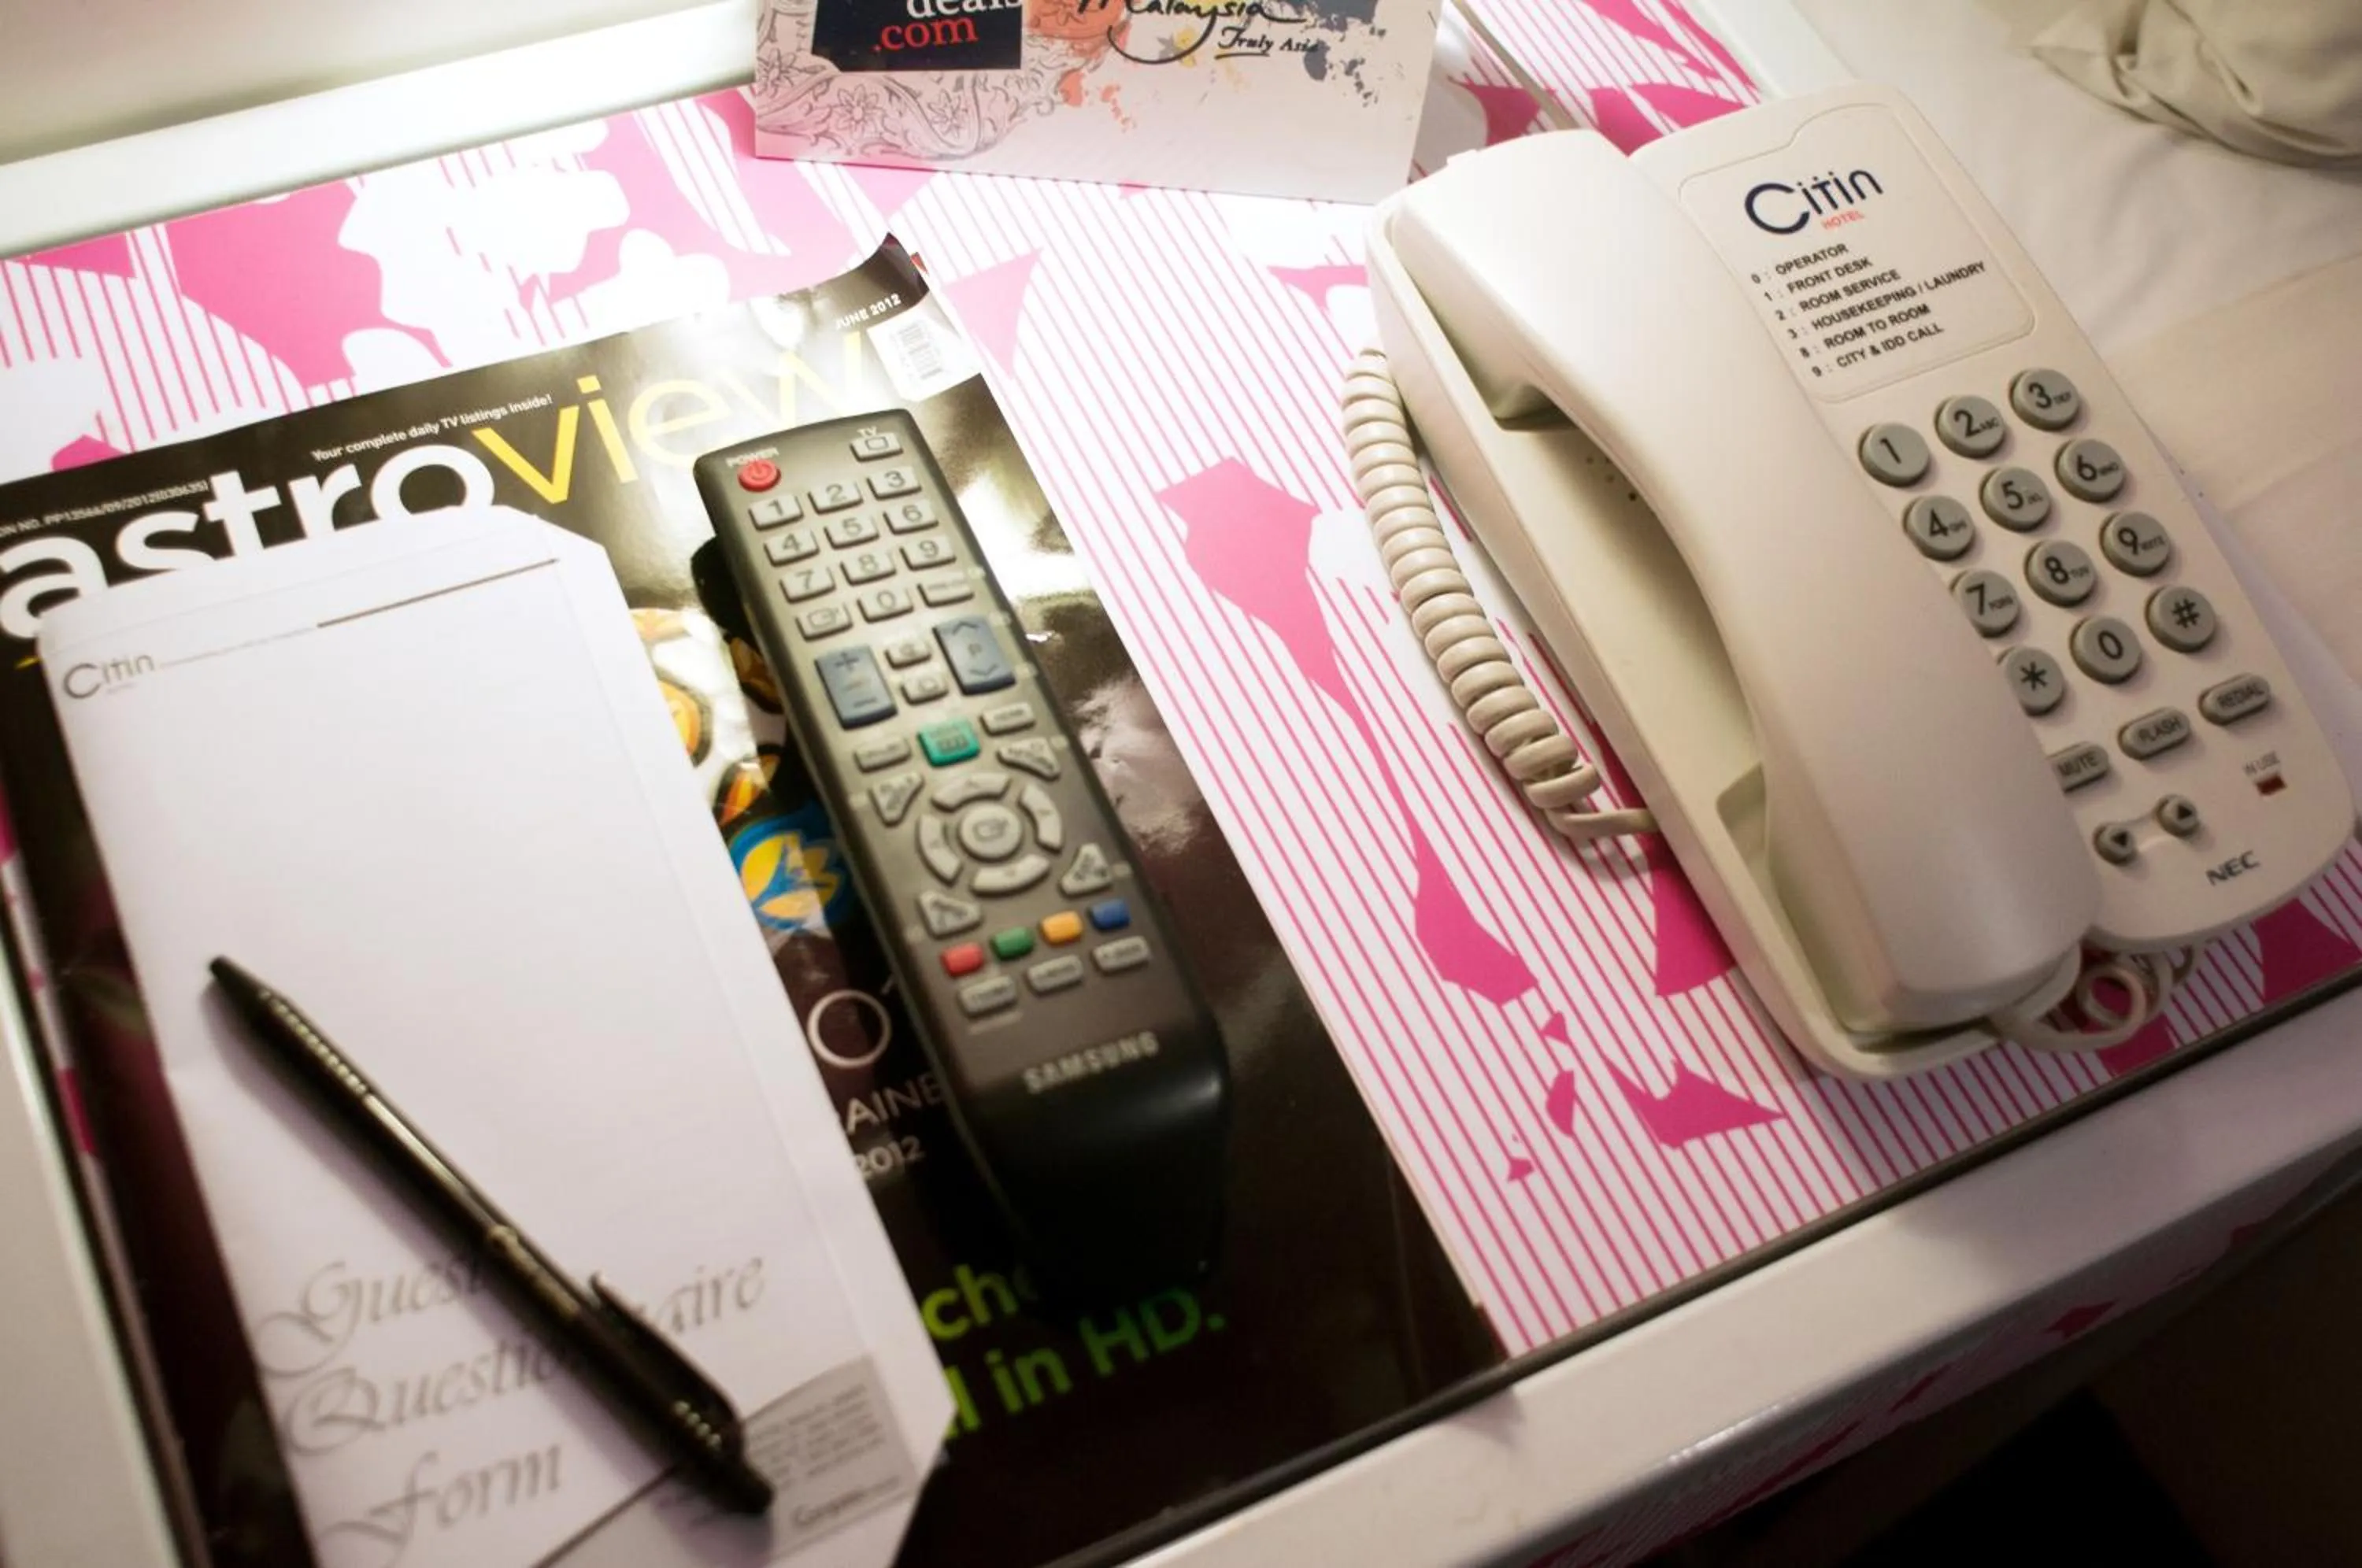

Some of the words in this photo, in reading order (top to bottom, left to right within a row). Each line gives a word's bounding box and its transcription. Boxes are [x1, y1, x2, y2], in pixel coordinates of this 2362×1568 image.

[906, 0, 1021, 19] dea
[872, 17, 979, 52] .com
[1218, 26, 1273, 54] Truly
[1279, 37, 1320, 53] Asia
[1821, 210, 1865, 231] HOTEL
[1750, 272, 1761, 284] 0
[1775, 243, 1849, 276] OPERATOR
[1763, 290, 1773, 302] 1
[1786, 272, 1833, 294] FRONT
[1836, 256, 1874, 279] DESK
[835, 308, 870, 331] JUNE
[869, 292, 902, 316] 2012
[1775, 309, 1786, 320] 2
[1798, 290, 1841, 313] ROOM
[1844, 268, 1901, 297] SERVICE
[1786, 327, 1798, 339] 3
[1810, 285, 1918, 331] HOUSEKEEPING
[1925, 260, 1987, 291] LAUNDRY
[1799, 346, 1811, 359] 8
[1823, 325, 1866, 350] ROOM
[1868, 316, 1888, 335] TO
[1889, 302, 1932, 327] ROOM
[1811, 364, 1823, 377] 9
[1835, 348, 1868, 369] CITY
[1869, 342, 1881, 357] &
[1882, 332, 1906, 352] IDD
[1906, 322, 1945, 343] CALL
[310, 445, 345, 463] Your
[346, 431, 407, 453] complete
[408, 420, 440, 438] daily
[439, 415, 460, 430] TV
[460, 405, 509, 426] listings
[509, 393, 553, 413] inside!
[1879, 436, 1903, 464] 1
[1953, 409, 1981, 438] 2
[2027, 382, 2052, 409] 3
[726, 446, 779, 468] POWER
[768, 499, 784, 517] 1
[825, 484, 848, 503] 2
[883, 470, 905, 489] 3
[1929, 508, 1949, 536] 4
[2001, 480, 2023, 510] 5
[2076, 454, 2097, 482] 6
[782, 533, 804, 552] 4
[842, 517, 864, 536] 5
[901, 504, 924, 523] 6
[794, 569, 815, 590] 7
[857, 553, 880, 574] 8
[917, 539, 940, 560] 9
[1965, 583, 1986, 616] 7
[2045, 556, 2070, 586] 8
[2117, 527, 2138, 556] 9
[876, 590, 898, 610] 0
[2097, 630, 2123, 660] 0
[2057, 753, 2100, 778] MUTE
[2138, 716, 2182, 743] FLASH
[2216, 682, 2265, 709] REDIAL
[2205, 850, 2260, 886] NEC
[1024, 1030, 1161, 1095] SAMSUNG
[846, 1072, 943, 1136] AINE
[983, 1346, 1073, 1415] in
[1077, 1286, 1229, 1378] HD.
